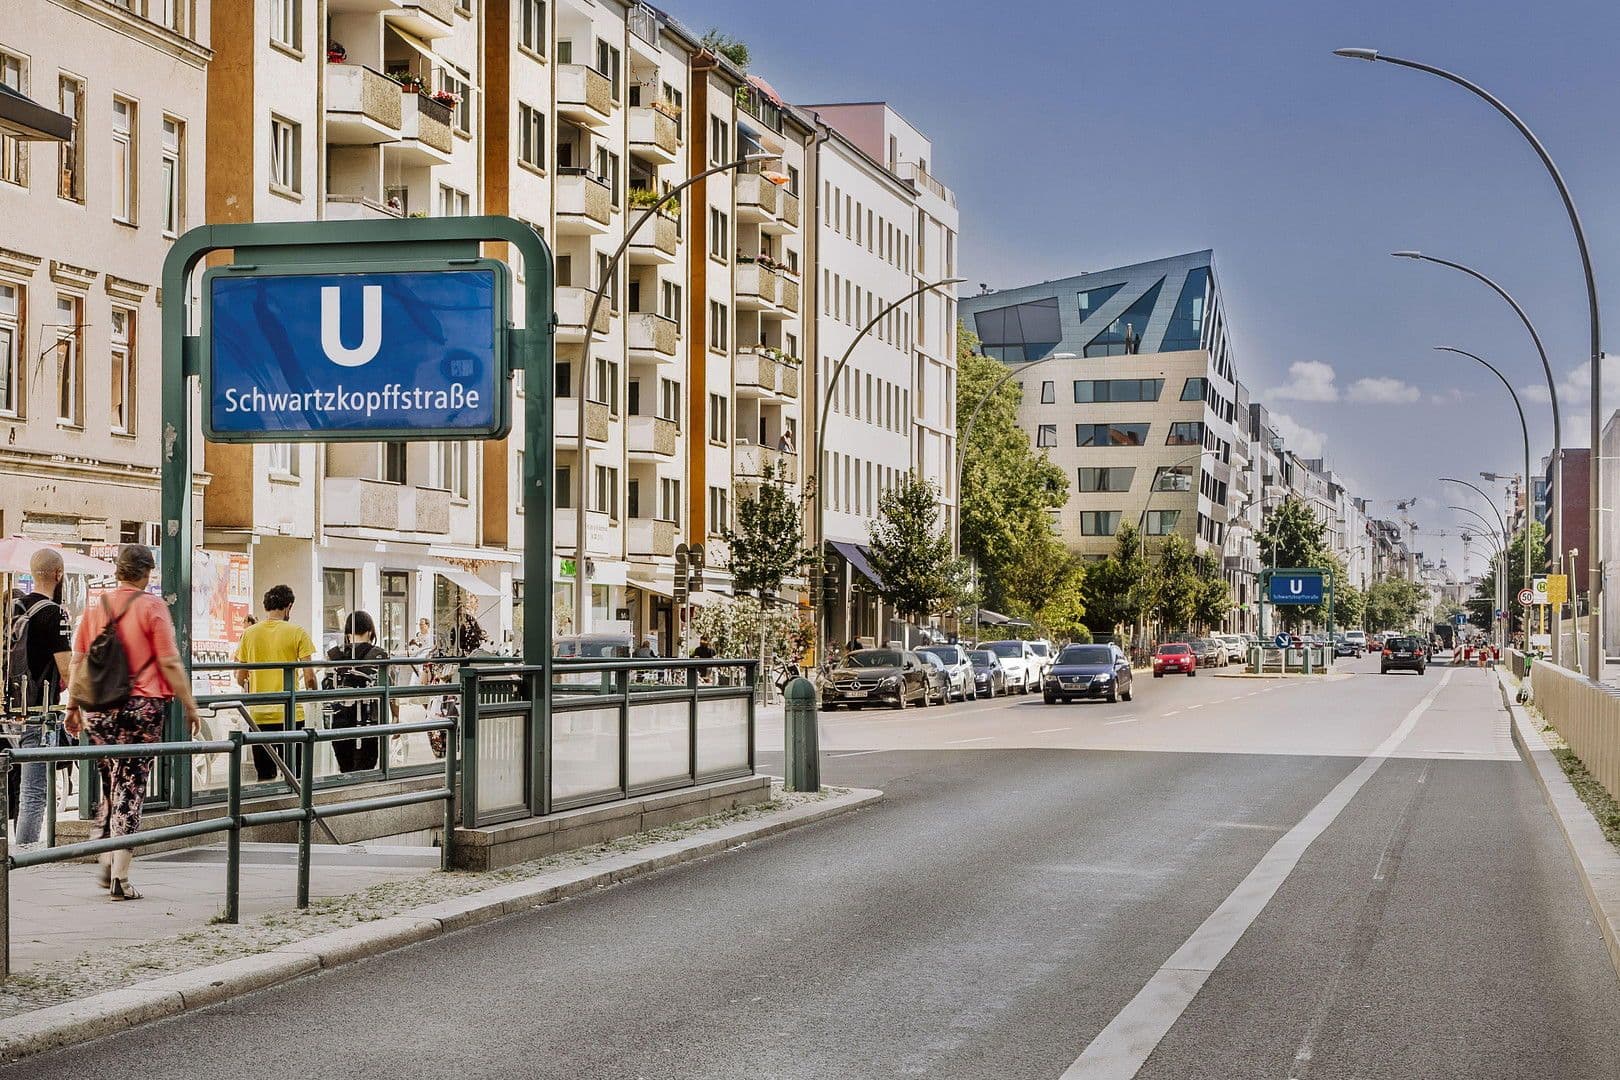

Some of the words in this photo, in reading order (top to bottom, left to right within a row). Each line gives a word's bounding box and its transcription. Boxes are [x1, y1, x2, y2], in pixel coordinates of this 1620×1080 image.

[321, 285, 382, 367] U
[225, 382, 480, 416] Schwartzkopffstraße
[1290, 579, 1303, 594] U
[1522, 593, 1532, 601] 50
